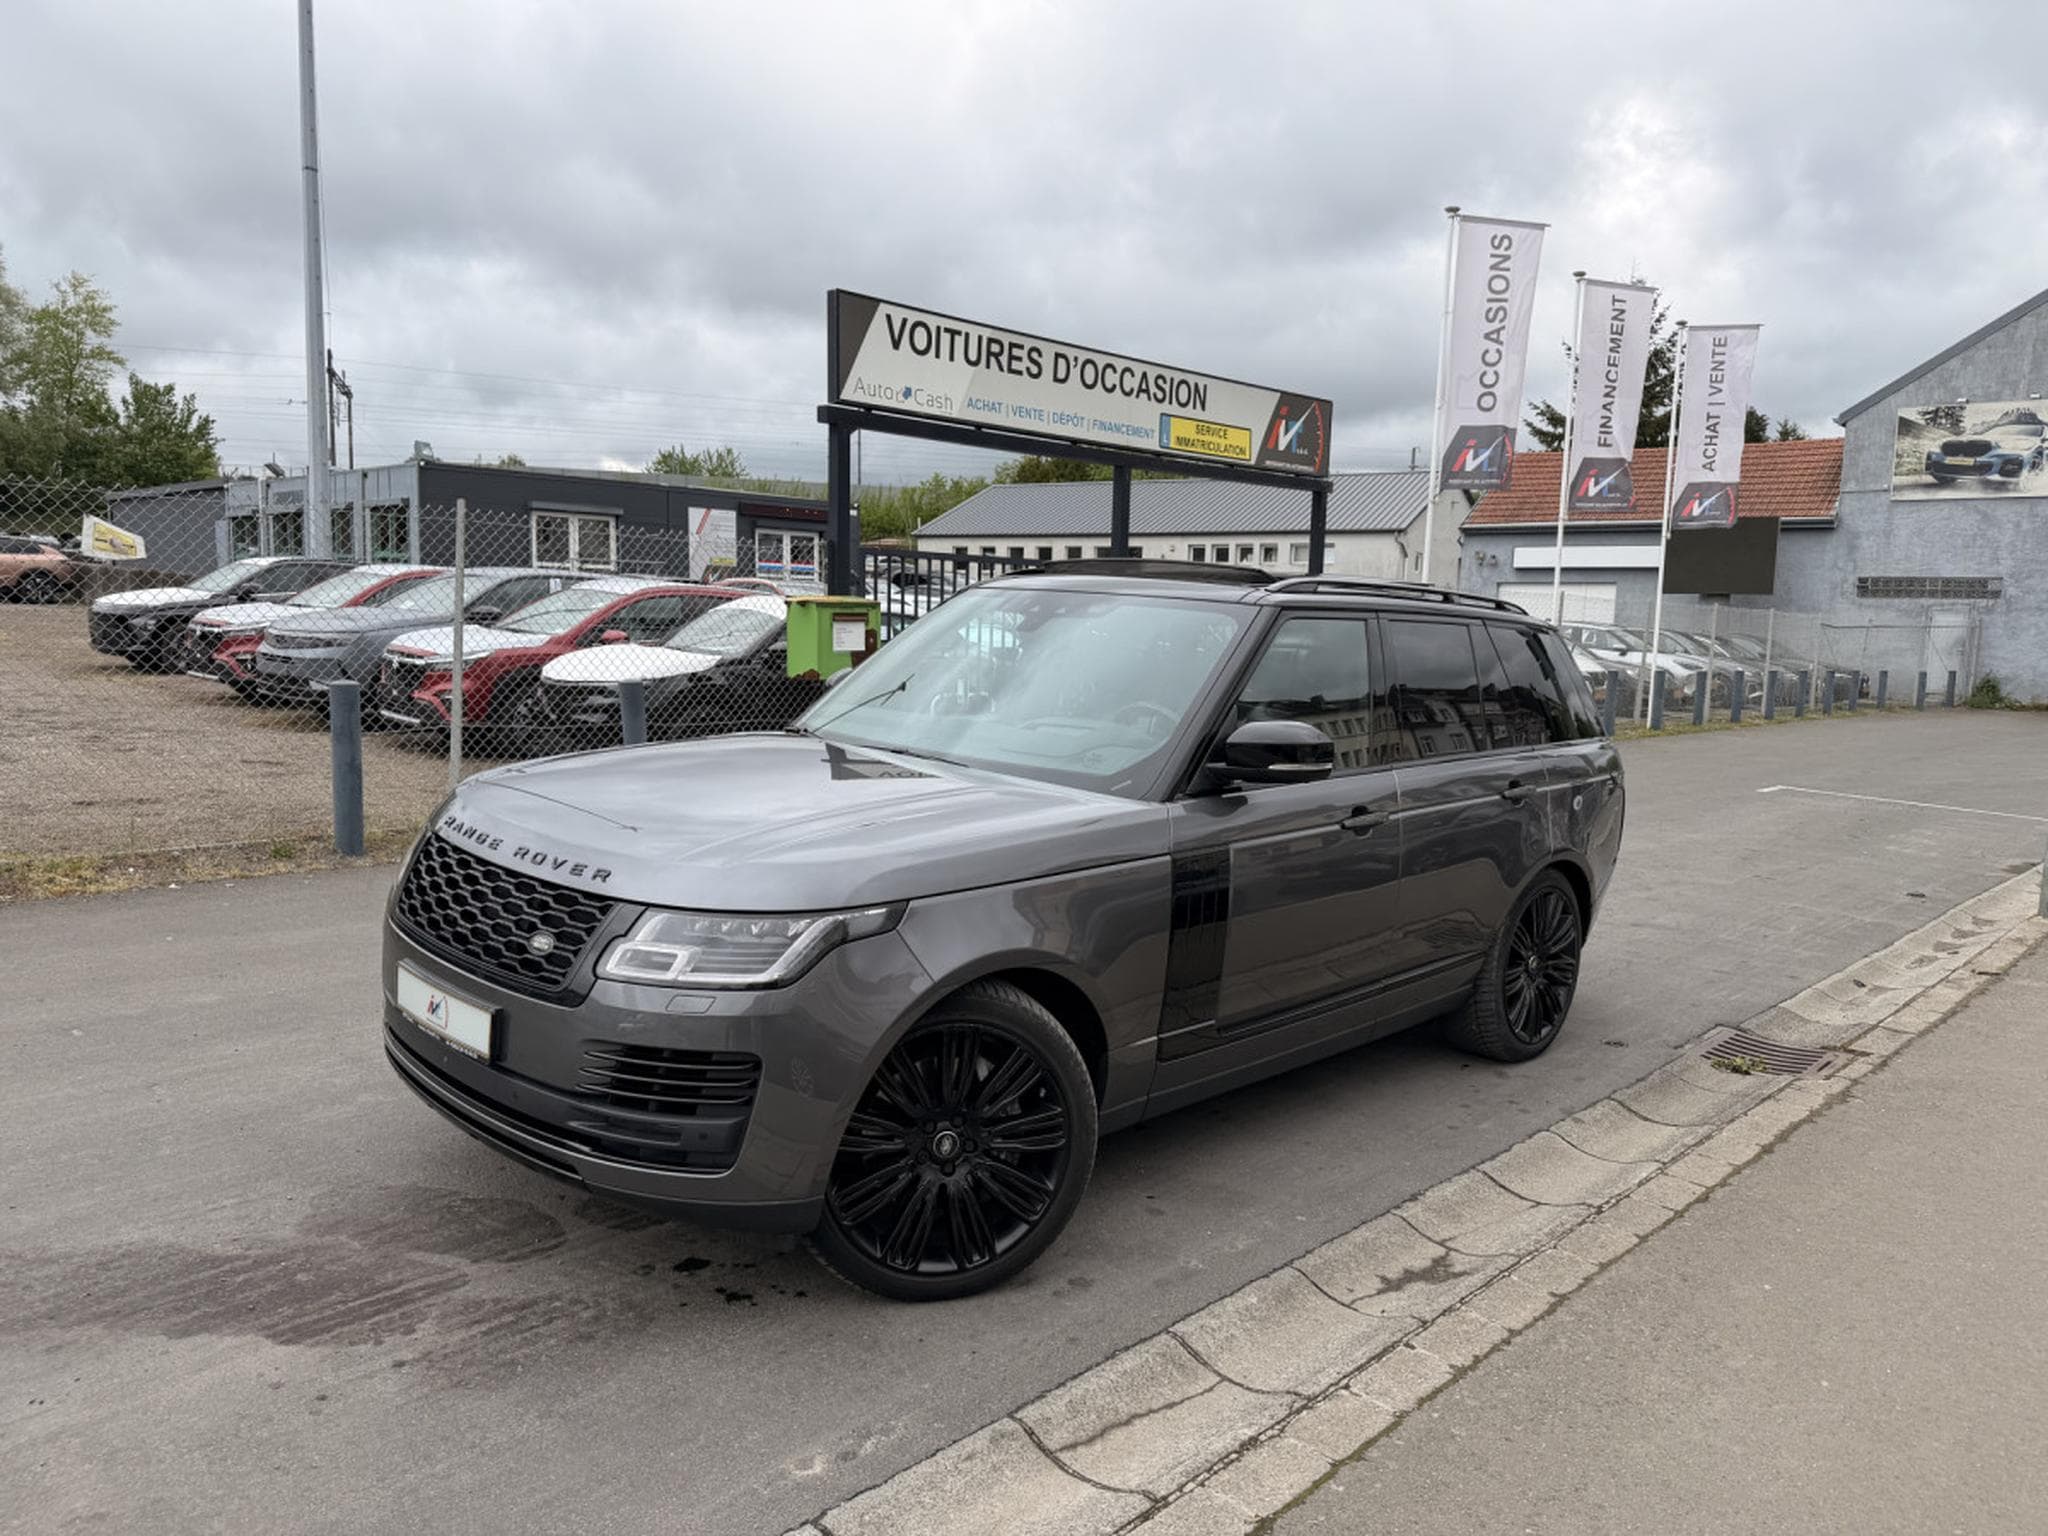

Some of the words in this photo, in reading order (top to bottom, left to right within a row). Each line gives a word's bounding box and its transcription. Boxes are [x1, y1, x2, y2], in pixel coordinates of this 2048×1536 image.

[1477, 233, 1513, 412] OCCASIONS
[885, 313, 1043, 380] VOITURES
[1053, 352, 1208, 412] D'OCCASION
[1597, 294, 1627, 448] FINANCEMENT
[1708, 336, 1728, 397] VENTE
[967, 398, 1003, 414] ACHAT
[1011, 405, 1045, 423] VENTE
[1092, 418, 1155, 440] FINANCEMENT
[1175, 436, 1248, 457] IMMATRICULATION
[1195, 424, 1229, 440] SERVICE
[1702, 412, 1721, 472] ACHAT
[444, 816, 504, 851] RANGE
[513, 846, 612, 883] ROVER
